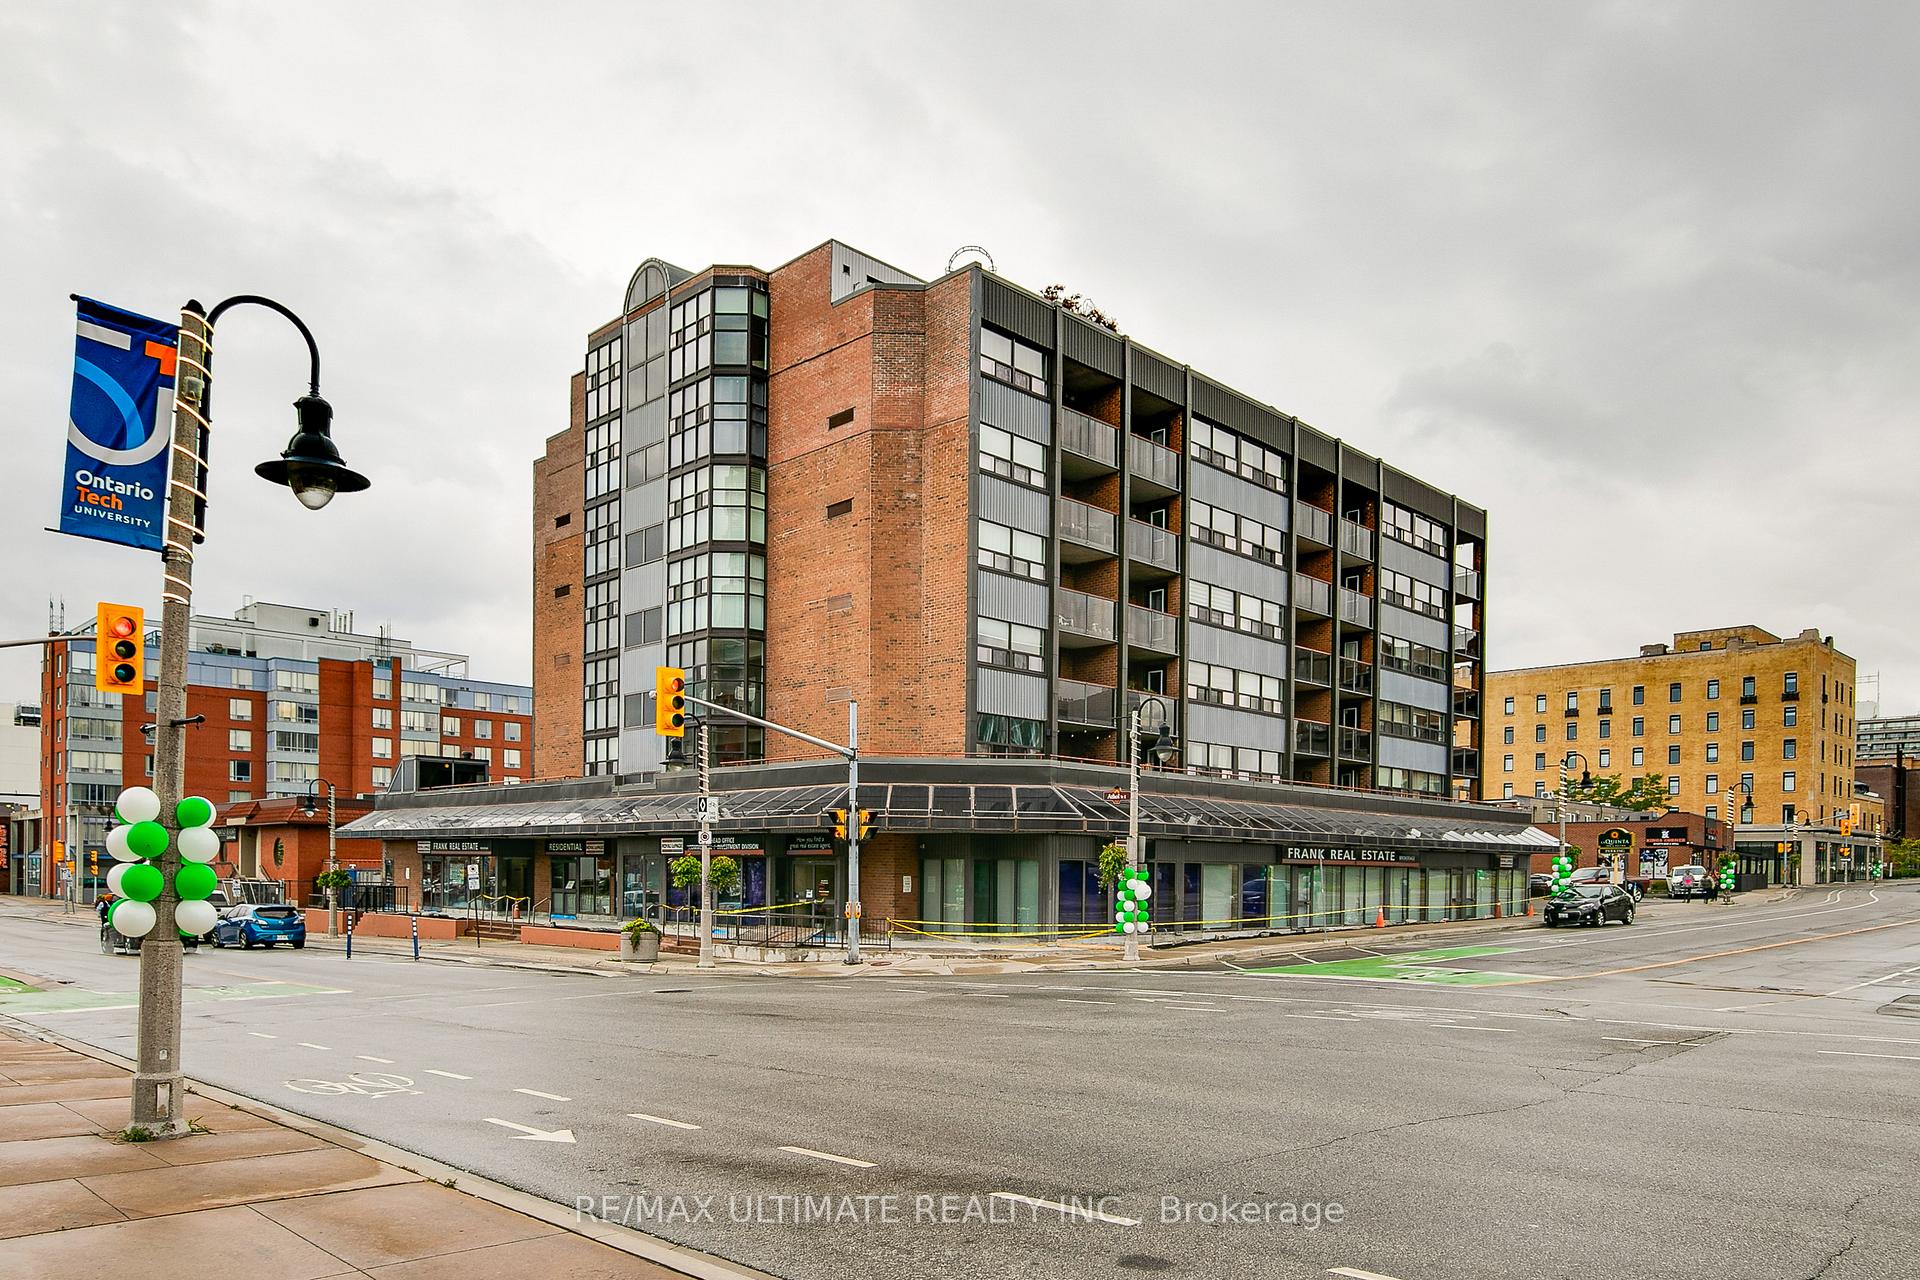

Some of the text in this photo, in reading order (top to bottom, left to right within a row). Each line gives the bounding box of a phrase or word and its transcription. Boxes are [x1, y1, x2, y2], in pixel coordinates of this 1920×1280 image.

[75, 469, 154, 501] Ontario
[76, 485, 123, 511] Tech
[74, 504, 151, 528] UNIVERSITY
[432, 842, 448, 850] FRANK
[449, 842, 461, 850] REAL
[461, 842, 479, 850] ESTATE
[548, 842, 583, 851] RESIDENTIAL
[1287, 847, 1325, 860] FRANK
[1330, 849, 1356, 861] REAL
[1361, 849, 1396, 861] ESTATE
